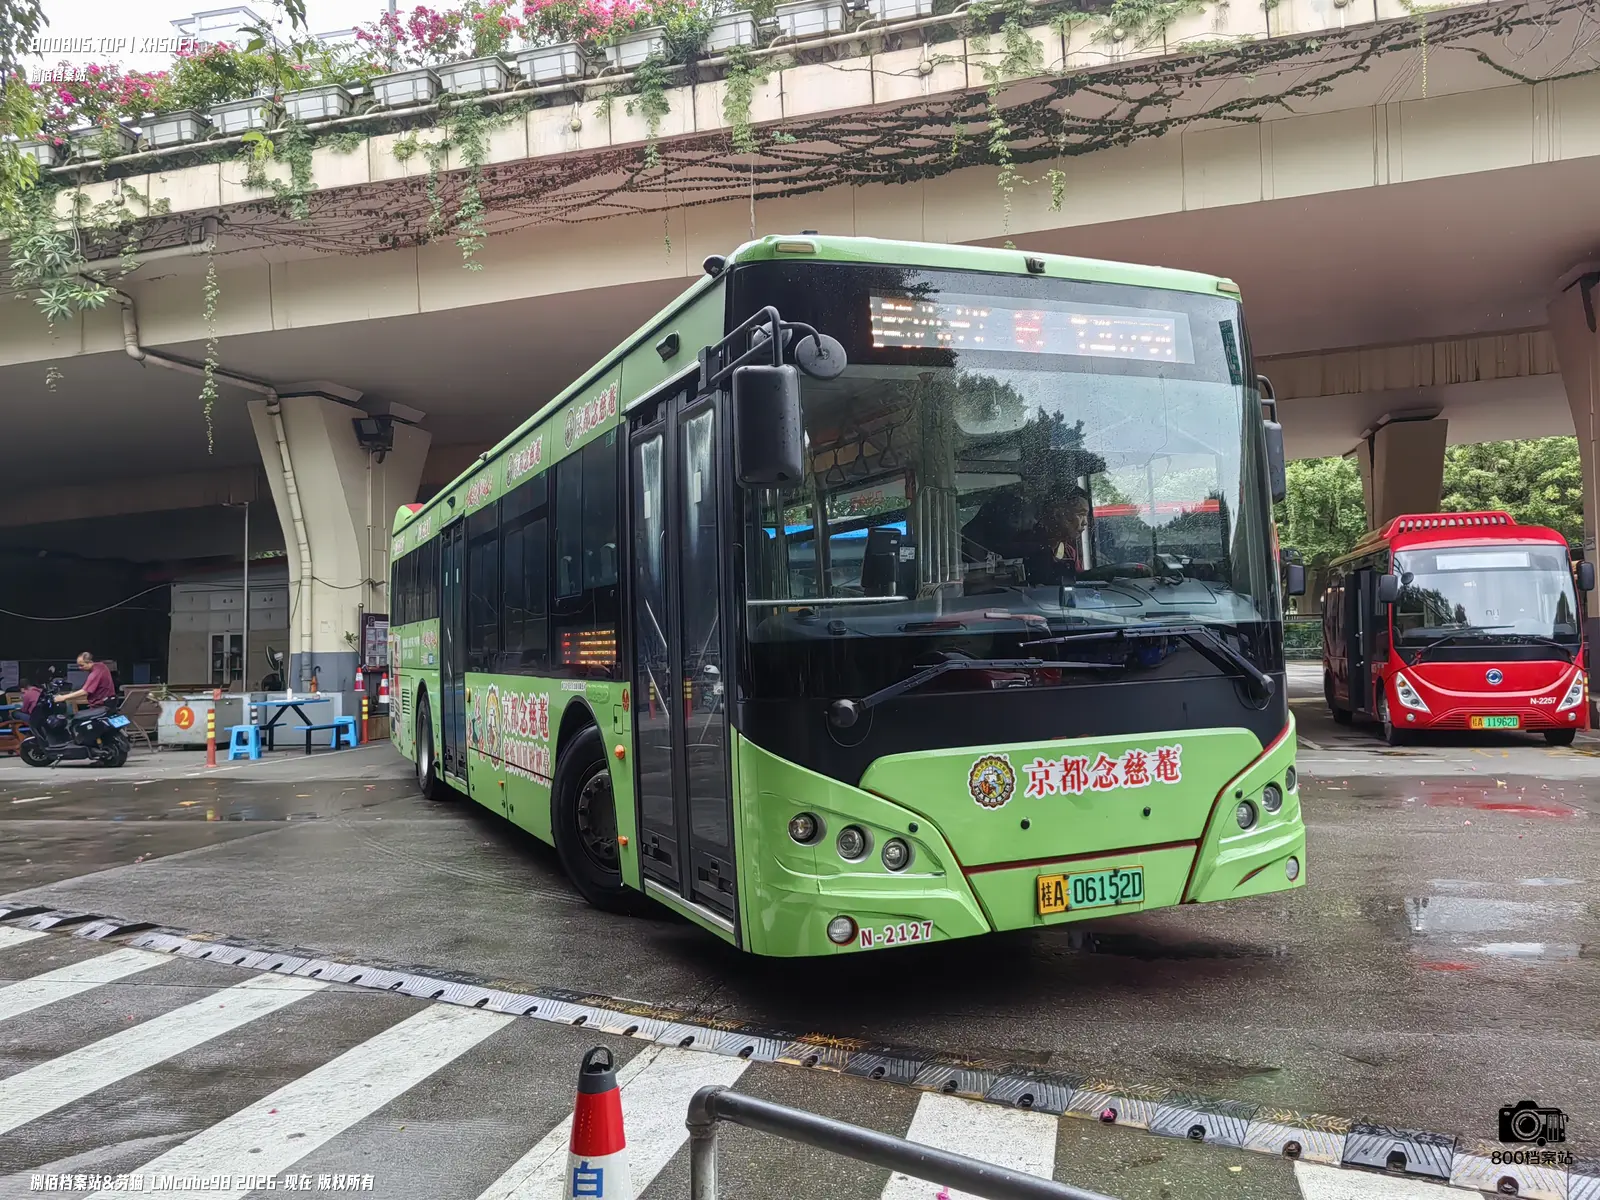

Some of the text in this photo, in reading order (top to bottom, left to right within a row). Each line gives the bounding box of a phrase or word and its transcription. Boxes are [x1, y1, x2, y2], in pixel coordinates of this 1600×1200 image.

[502, 691, 549, 741] 京都念慈菴
[1530, 696, 1557, 705] N-2257
[179, 709, 190, 726] 2
[1486, 716, 1518, 727] 11962D
[1023, 748, 1180, 797] 京都念慈菴
[1040, 872, 1143, 908] 桂A 06152D
[860, 920, 933, 948] N-2127
[573, 1160, 604, 1198] 白
